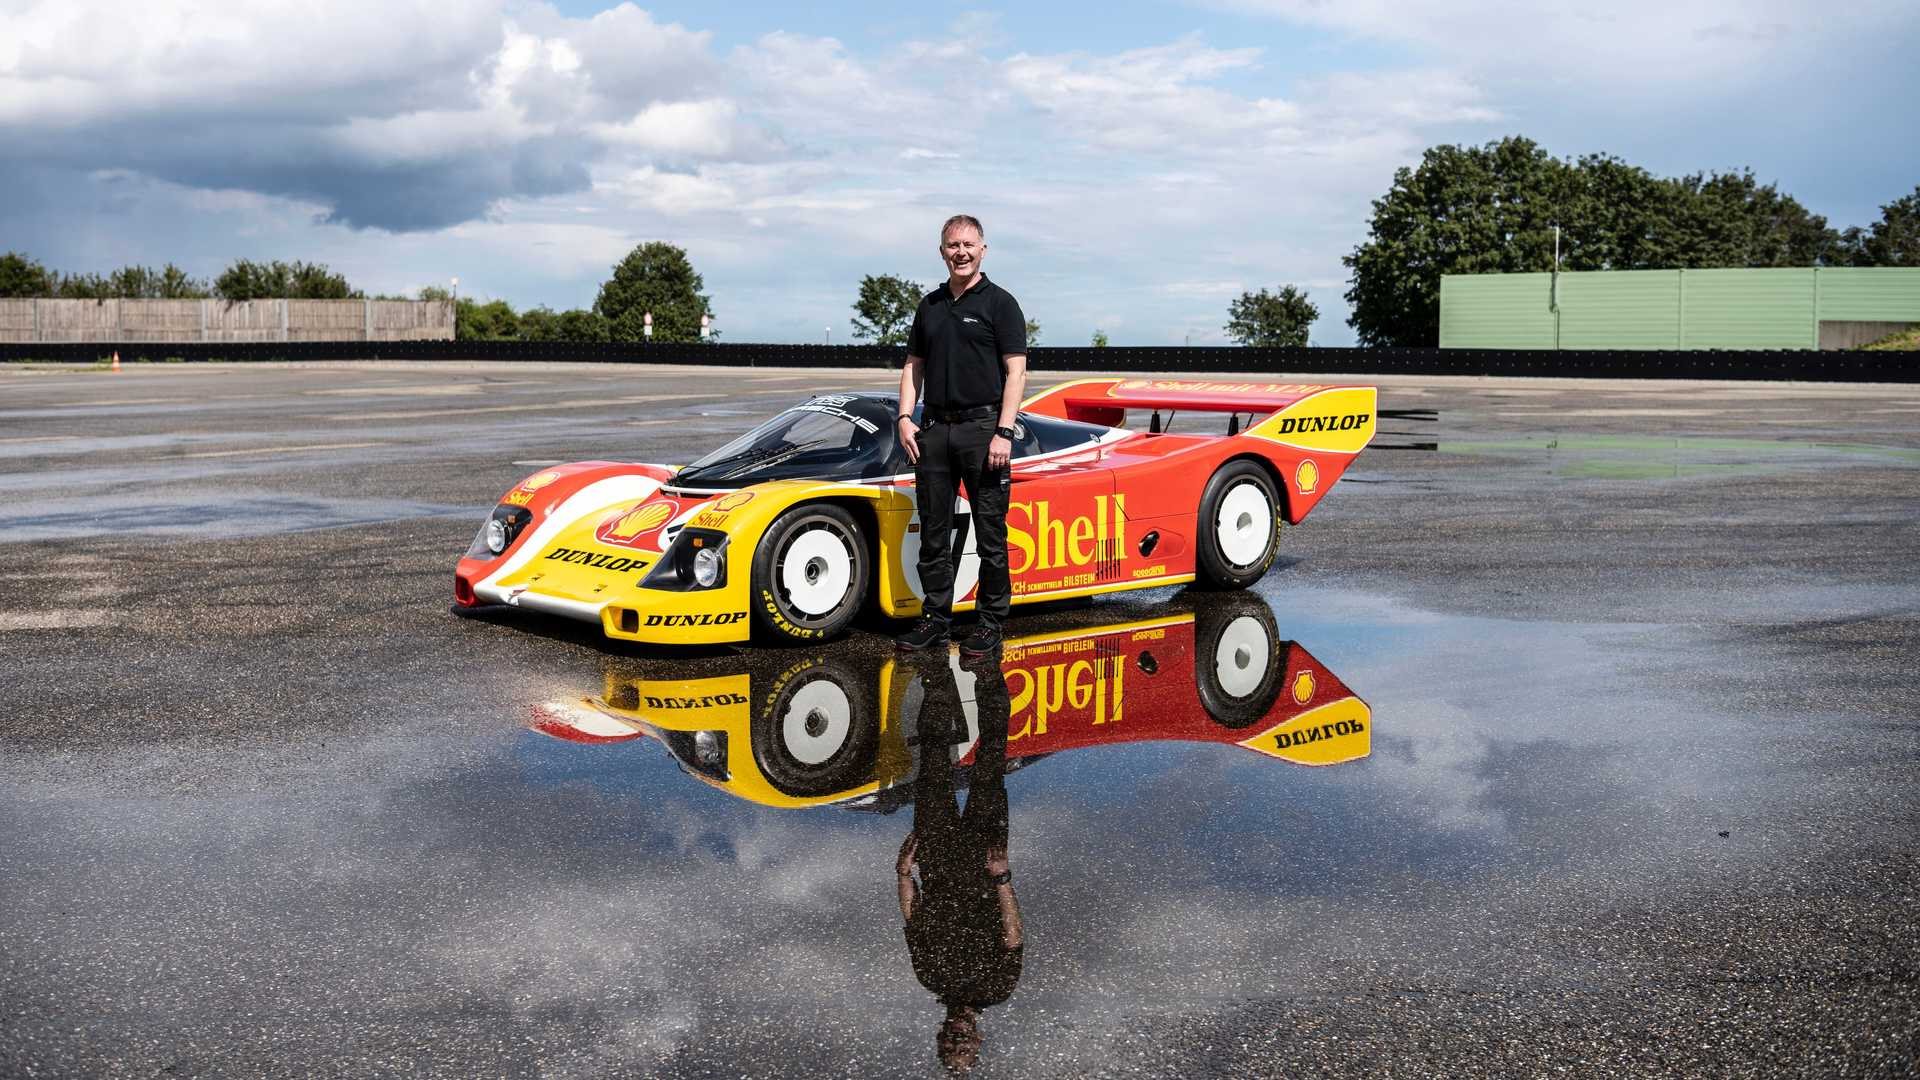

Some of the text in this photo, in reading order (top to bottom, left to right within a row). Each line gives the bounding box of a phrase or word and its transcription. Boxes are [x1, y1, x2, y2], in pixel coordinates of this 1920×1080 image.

[1278, 414, 1370, 434] DUNLOP
[504, 491, 535, 505] Shell
[692, 512, 729, 528] Shell
[1006, 493, 1128, 575] Shell
[545, 548, 649, 573] DUNLOP
[1063, 572, 1096, 587] BILSTEIN
[644, 611, 747, 627] DUNLOP
[762, 590, 813, 638] DUNLOP
